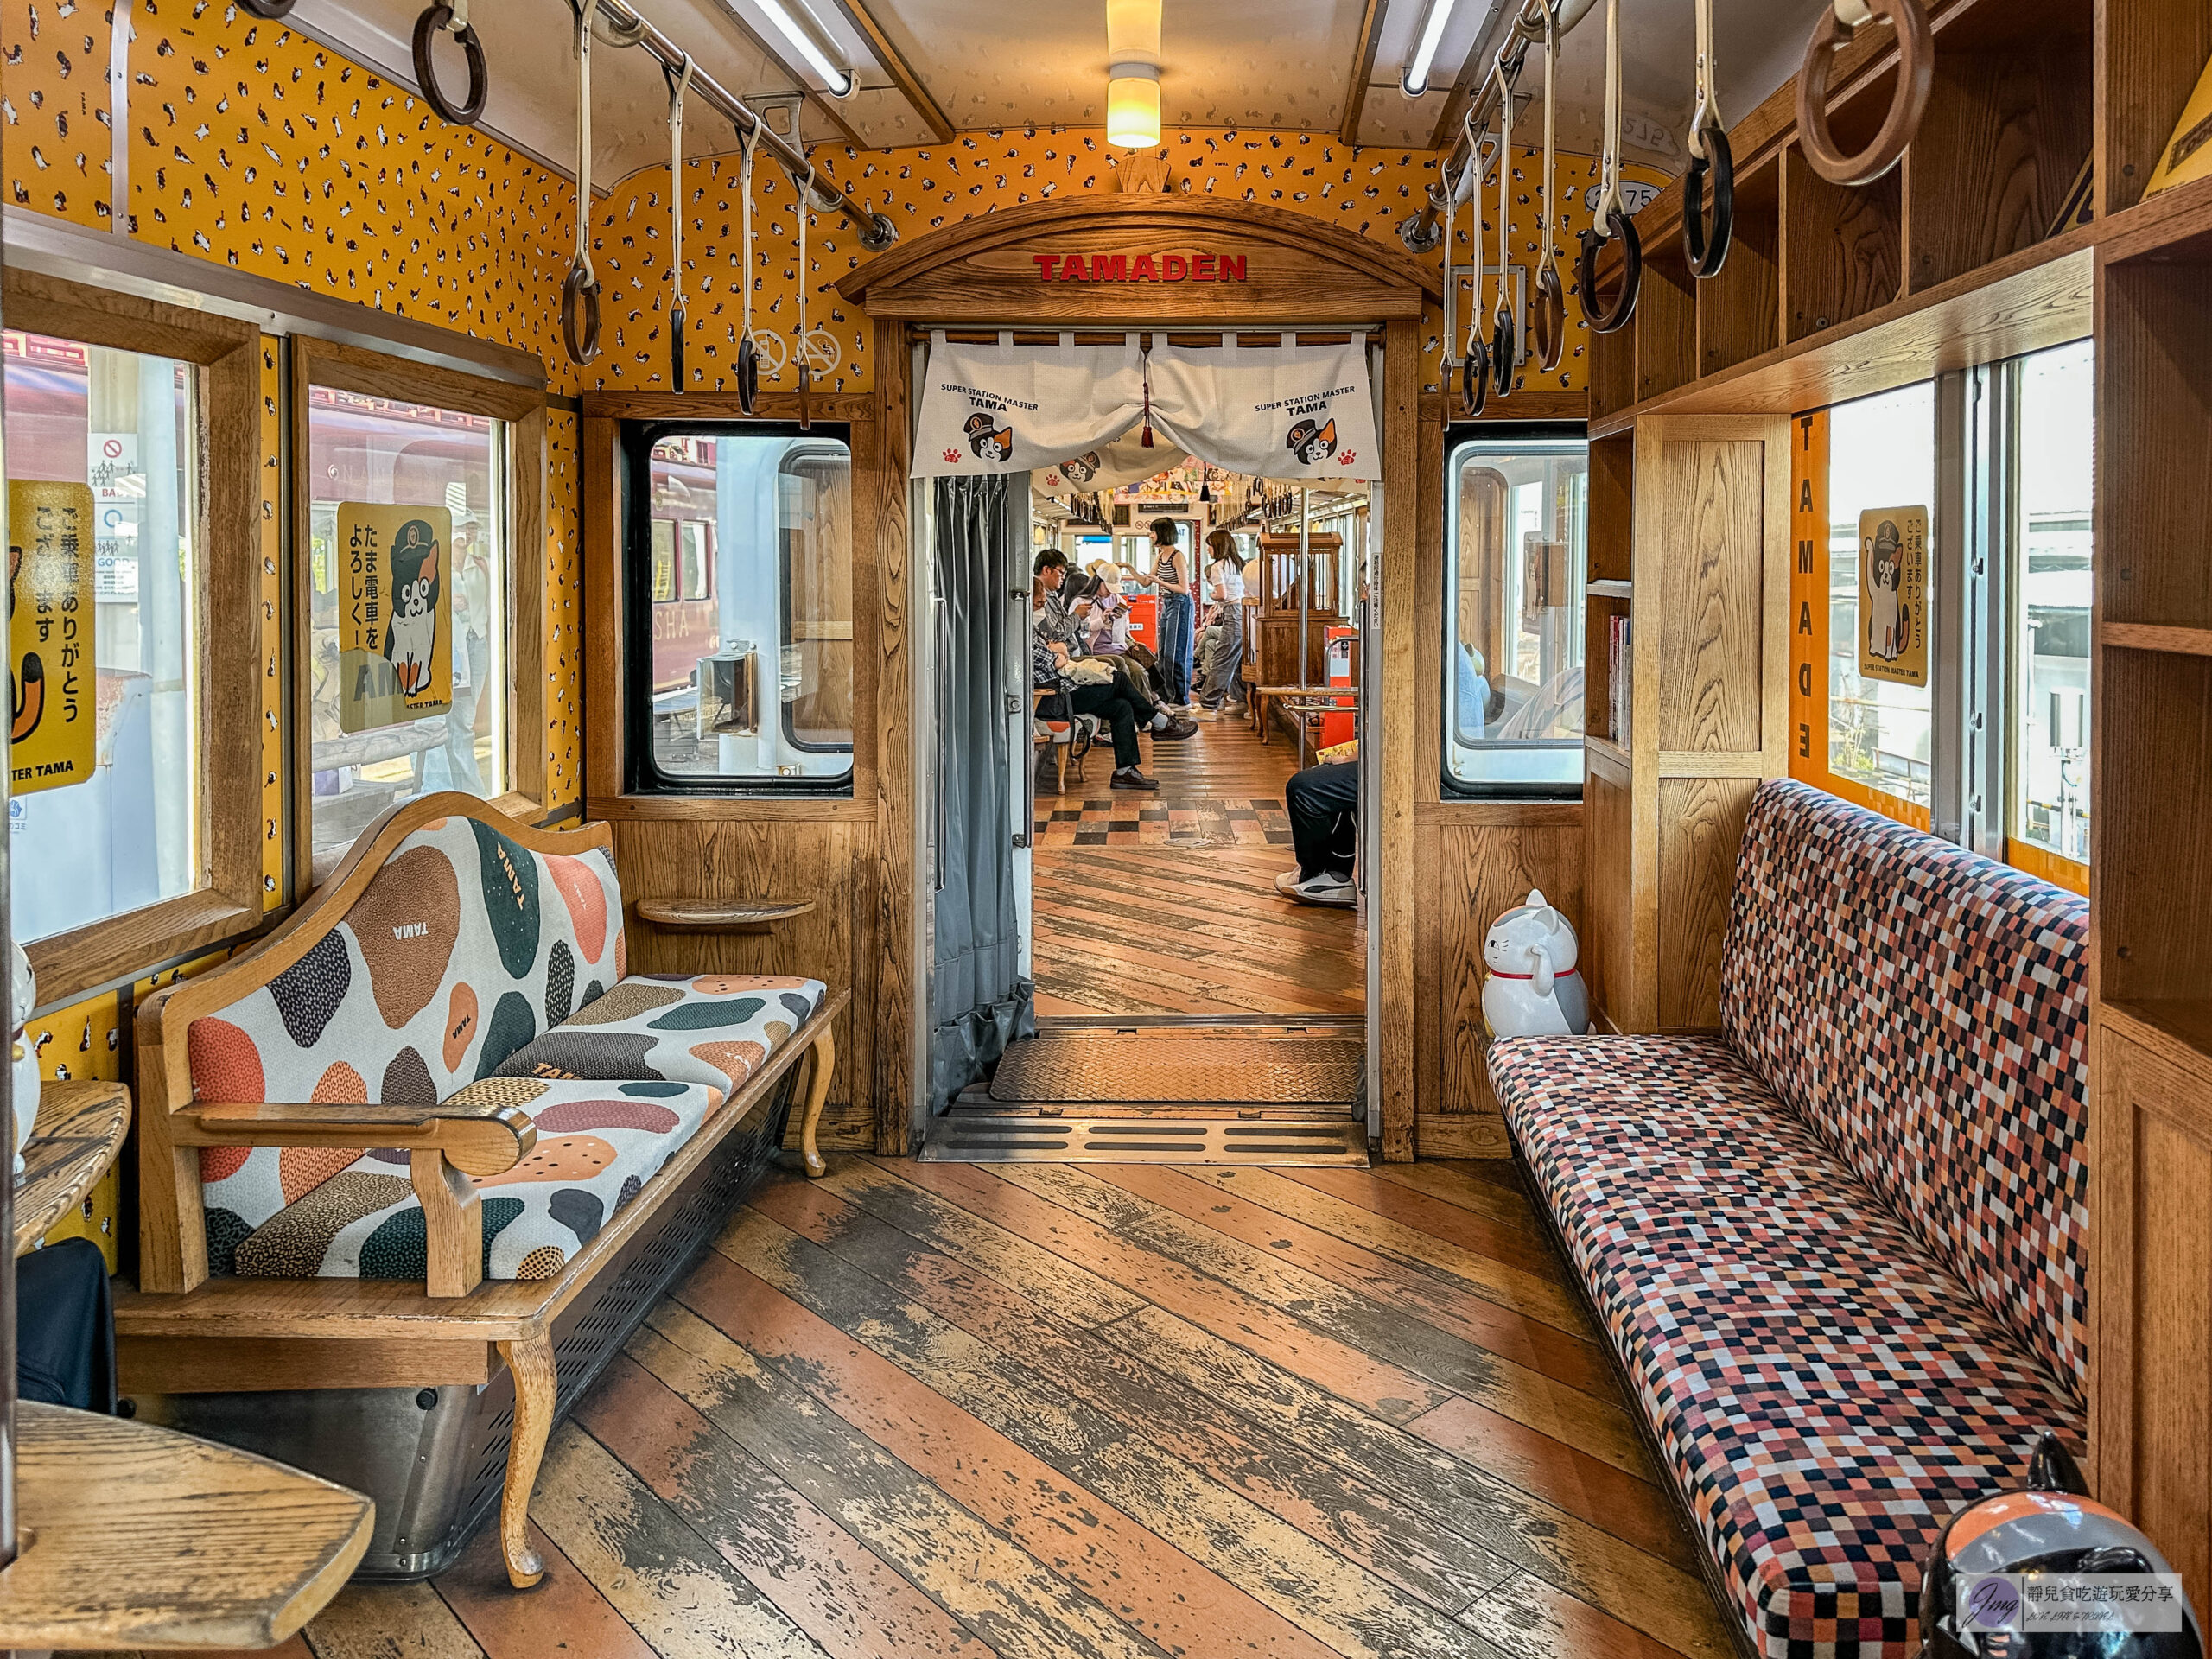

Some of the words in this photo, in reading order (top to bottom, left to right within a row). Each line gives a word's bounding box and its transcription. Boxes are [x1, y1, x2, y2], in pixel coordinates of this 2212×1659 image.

[1595, 189, 1652, 207] 275
[1033, 255, 1247, 282] TAMADEN
[941, 384, 967, 393] SUPER
[968, 388, 1001, 401] STATION
[1004, 397, 1039, 410] MASTER
[969, 397, 1007, 411] TAMA
[1255, 402, 1281, 411] SUPER
[1284, 393, 1320, 407] STATION
[1322, 386, 1355, 398] MASTER
[1287, 401, 1327, 416] TAMA
[35, 506, 54, 642] ござます
[365, 524, 378, 650] たま電車を
[654, 609, 689, 640] SHA
[35, 760, 73, 777] TAMA
[497, 842, 525, 911] TAMA
[392, 922, 429, 940] TAMA
[452, 1014, 471, 1039] TAMA
[531, 1063, 582, 1079] TAM
